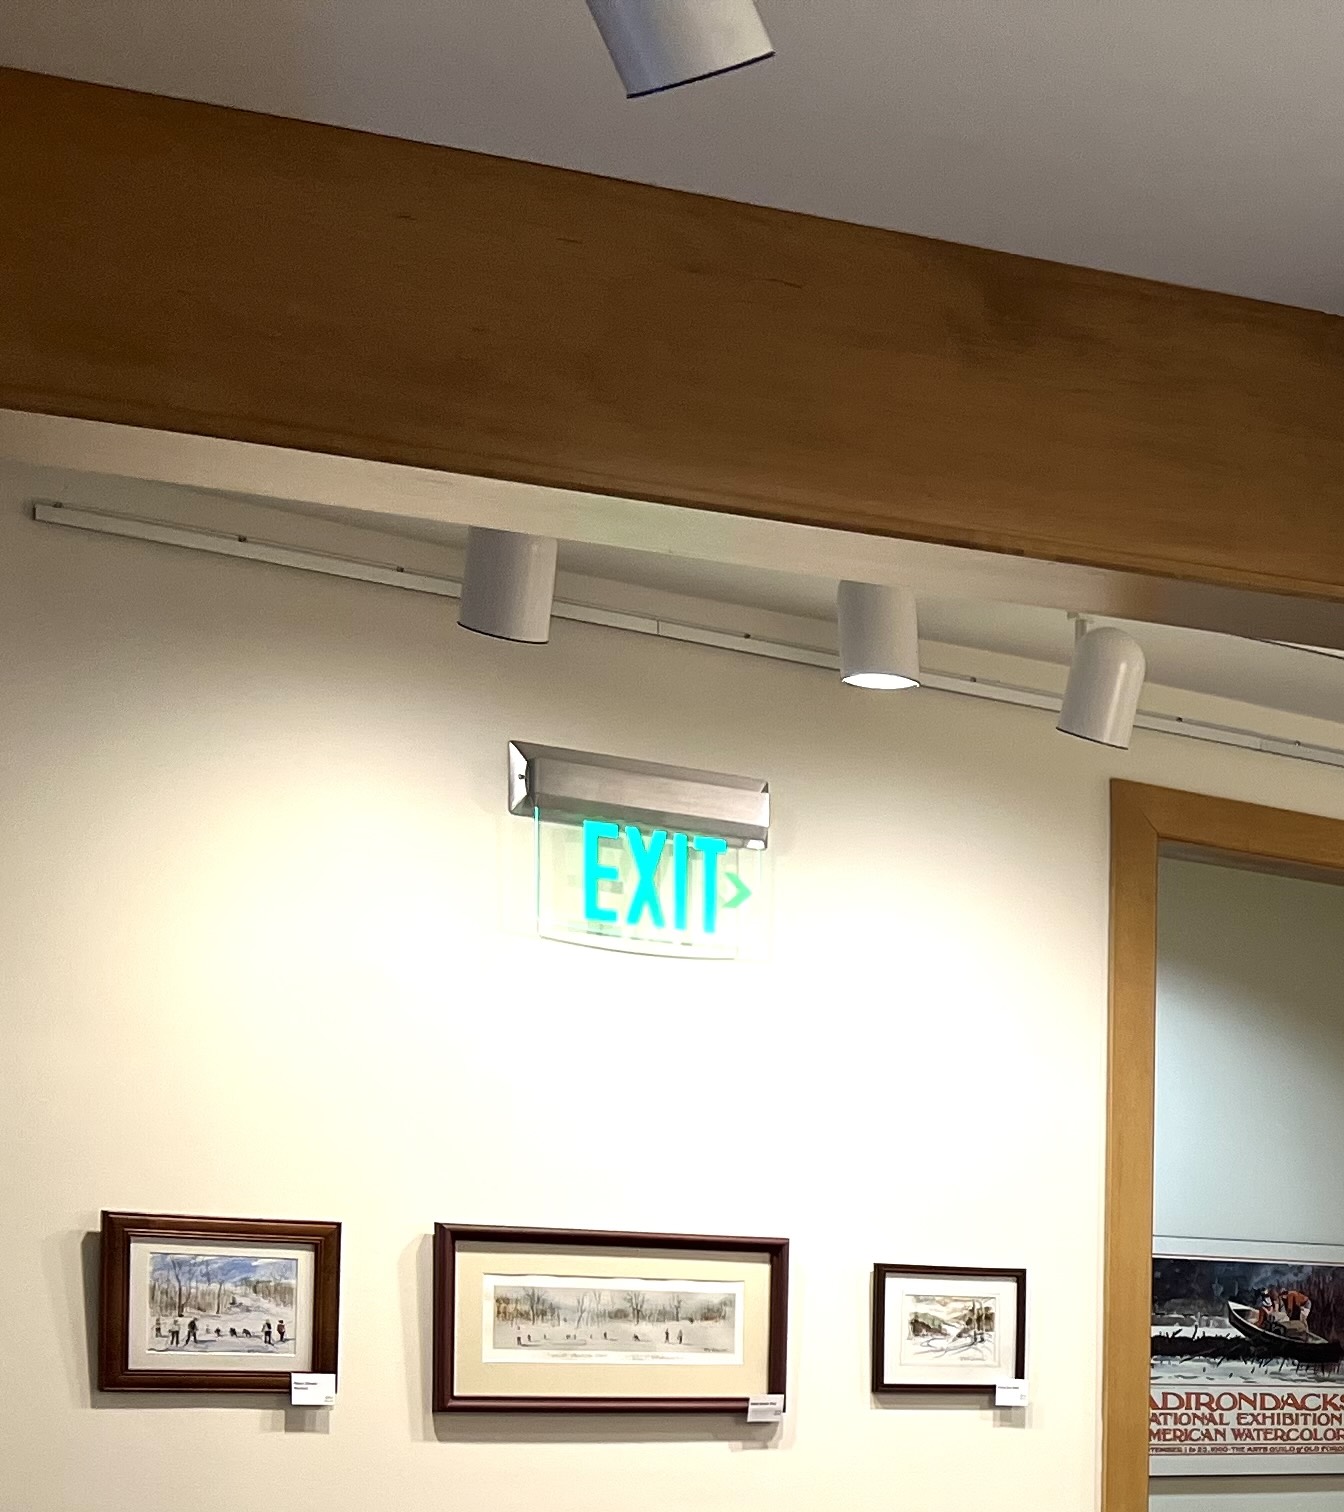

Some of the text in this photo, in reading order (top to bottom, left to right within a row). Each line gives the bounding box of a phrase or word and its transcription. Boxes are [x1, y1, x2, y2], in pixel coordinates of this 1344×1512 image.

[583, 819, 728, 934] EXIT
[1149, 1412, 1230, 1426] ATIONAL
[1236, 1412, 1342, 1426] EXHIBITION
[1149, 1427, 1226, 1442] MERICAN
